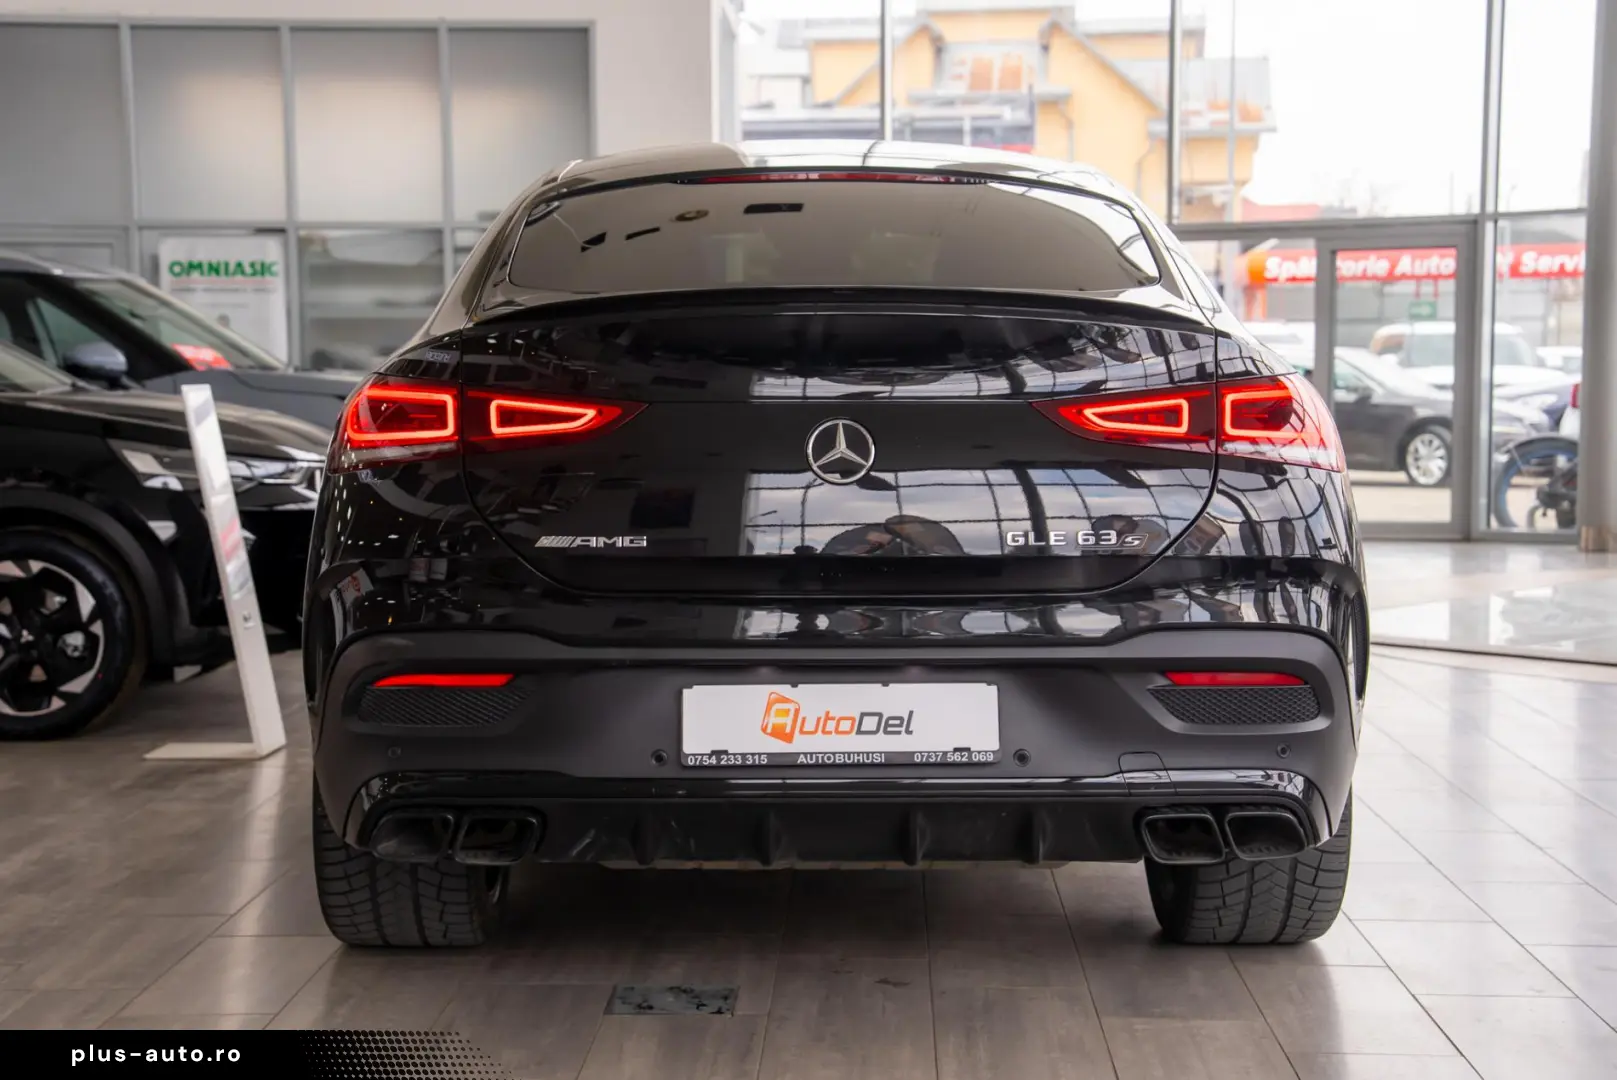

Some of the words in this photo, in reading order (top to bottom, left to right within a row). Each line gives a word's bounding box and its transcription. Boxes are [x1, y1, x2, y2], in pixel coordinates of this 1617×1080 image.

[1395, 254, 1456, 277] Auto
[1520, 250, 1585, 274] Servi
[570, 536, 647, 547] AMG
[1006, 531, 1067, 546] GLE
[763, 702, 914, 738] AutoDel
[687, 756, 717, 766] 0754
[720, 755, 743, 765] 233
[745, 754, 768, 765] 315
[797, 752, 885, 764] AUTOBUHUSI
[914, 751, 943, 763] 0737
[946, 751, 969, 763] 562
[972, 751, 994, 762] 069
